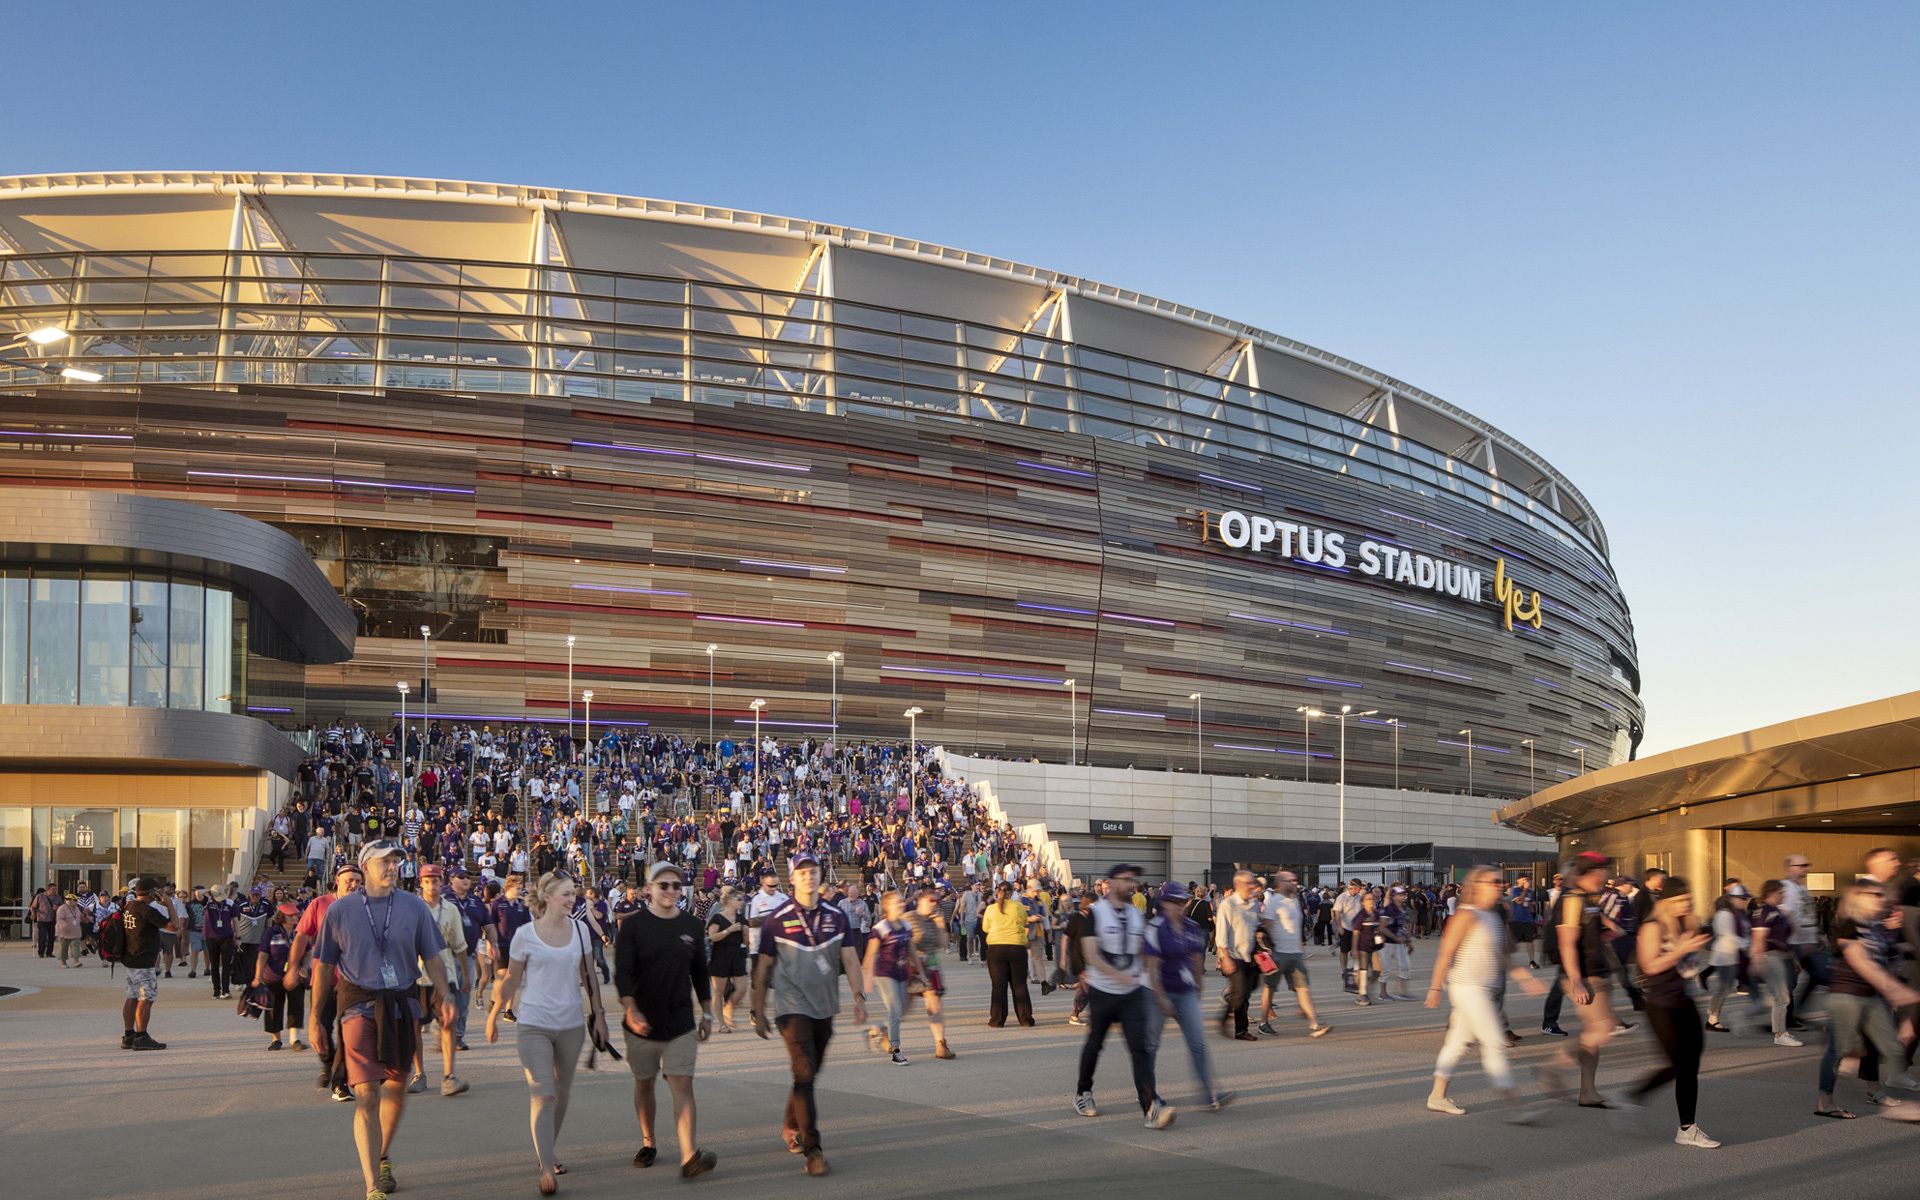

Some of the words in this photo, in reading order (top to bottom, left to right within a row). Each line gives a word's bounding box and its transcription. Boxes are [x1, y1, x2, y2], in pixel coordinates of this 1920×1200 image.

[1219, 510, 1346, 568] OPTUS
[1358, 541, 1481, 602] STADIUM
[1102, 822, 1117, 831] Gate
[1117, 823, 1123, 831] 4
